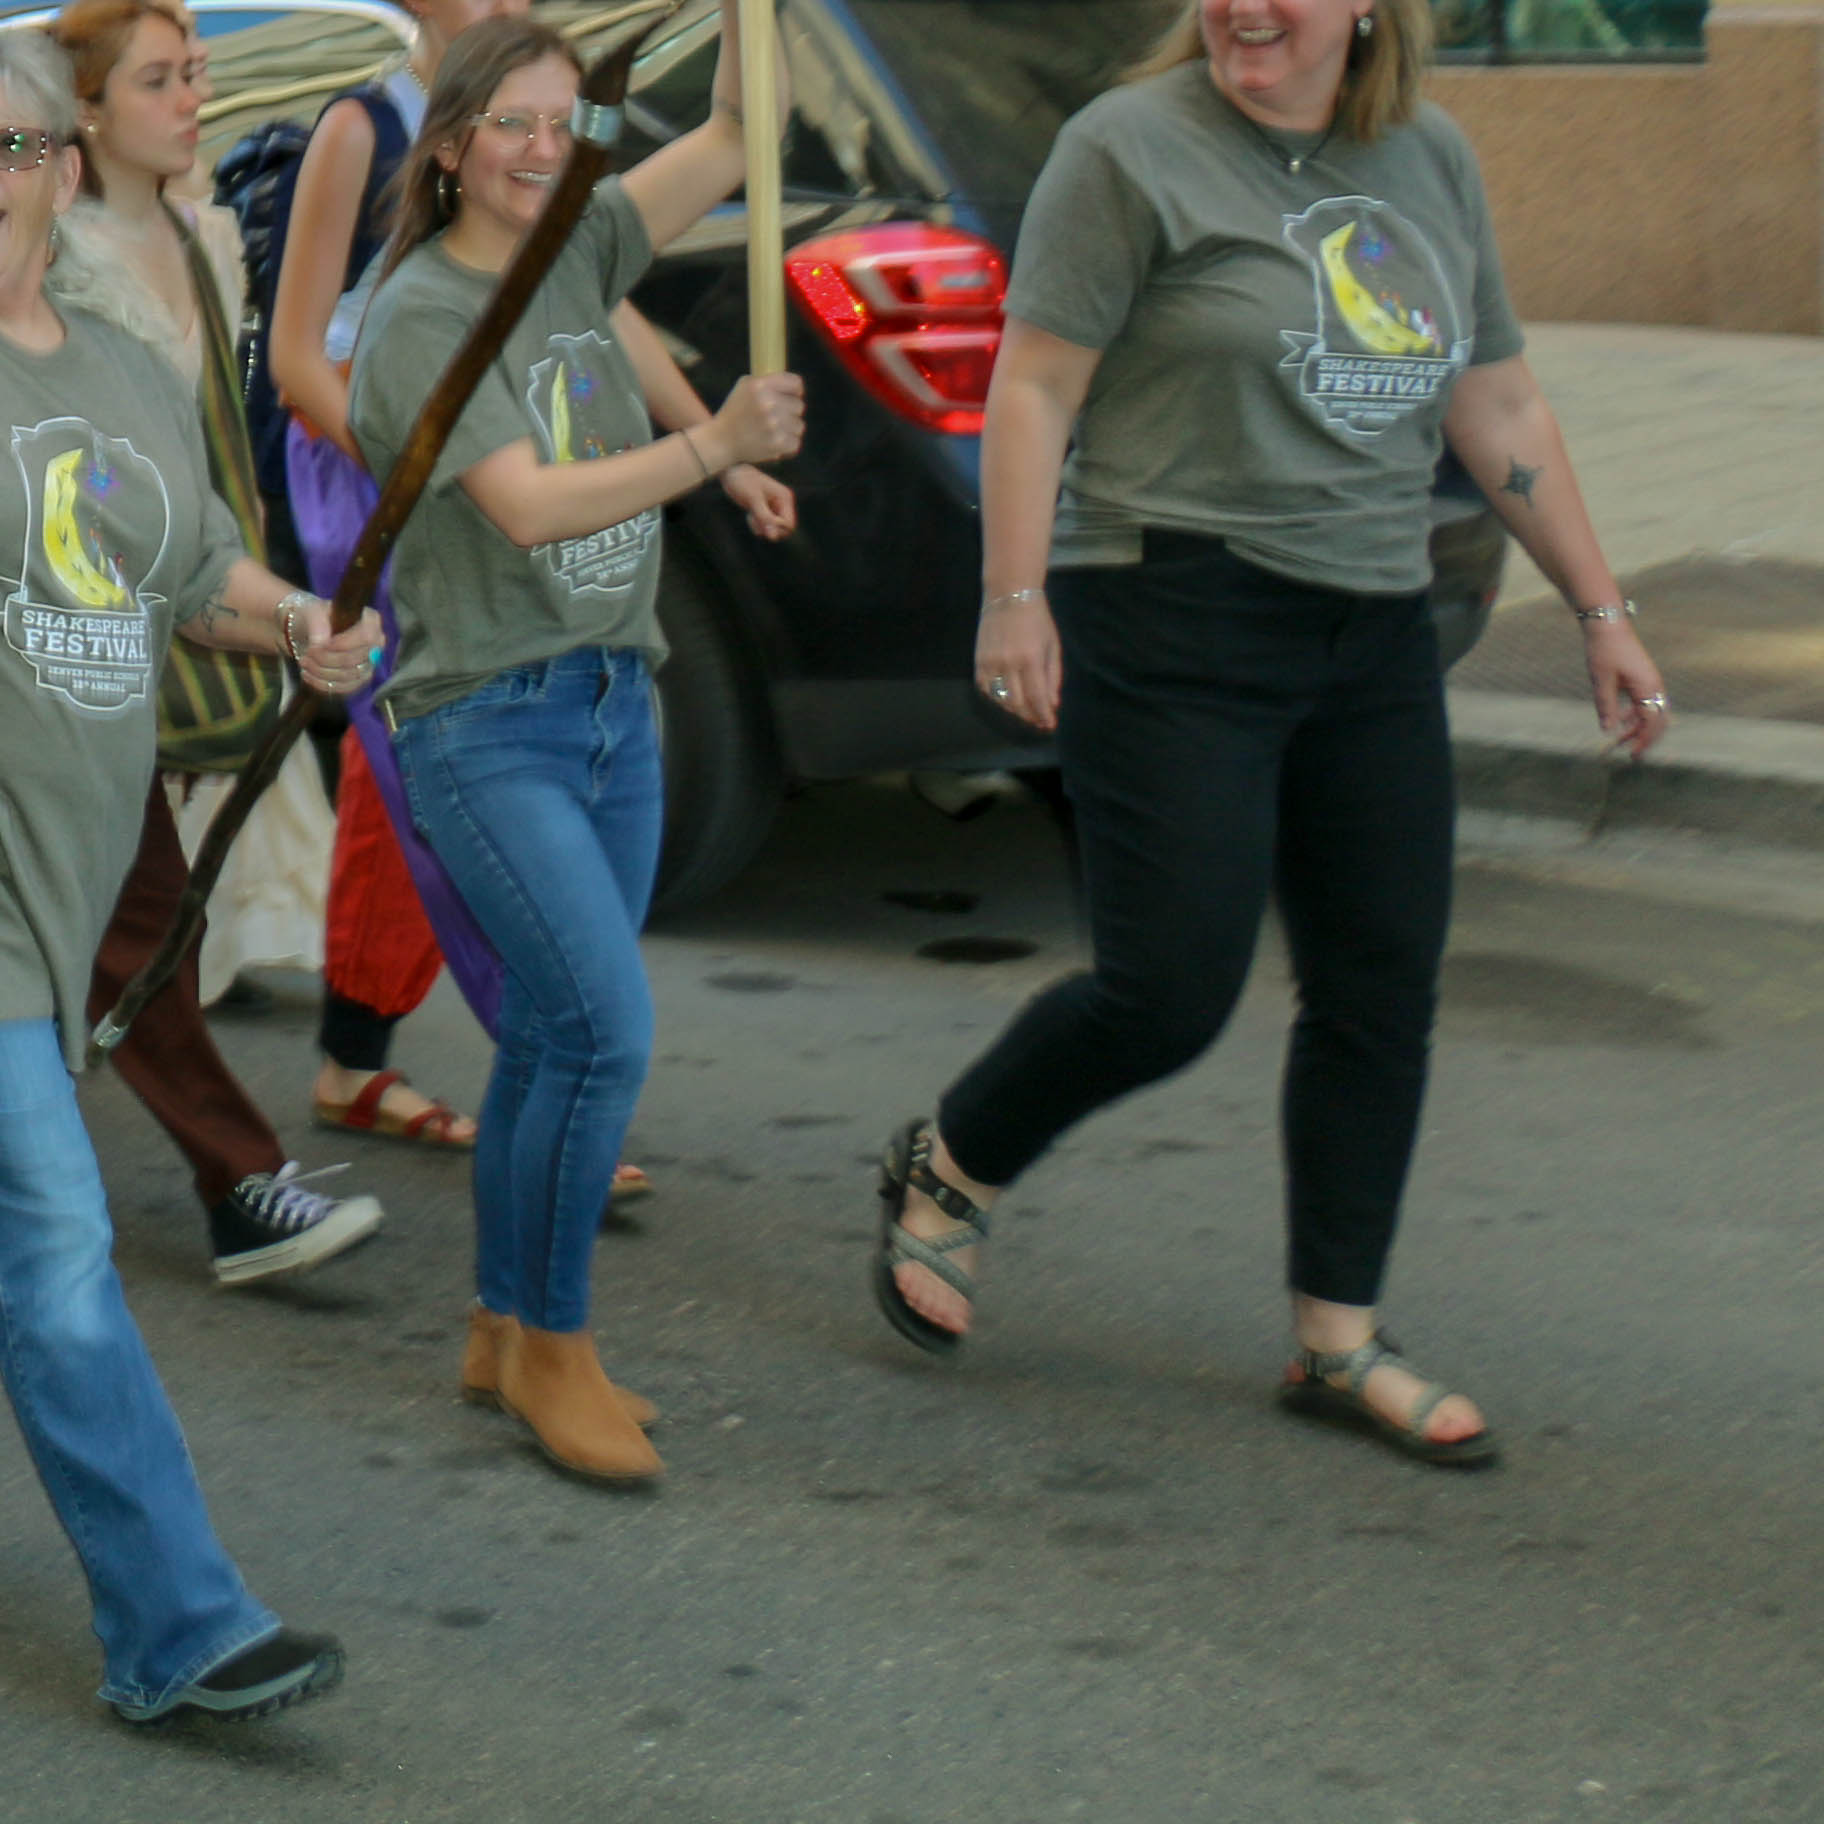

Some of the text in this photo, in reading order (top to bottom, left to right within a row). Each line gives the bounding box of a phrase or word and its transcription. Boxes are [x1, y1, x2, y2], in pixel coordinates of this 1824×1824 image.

[1318, 359, 1449, 375] SHAKESPEARE
[22, 610, 145, 634] SHAKESPEARE
[24, 628, 147, 658] FESTIVAL
